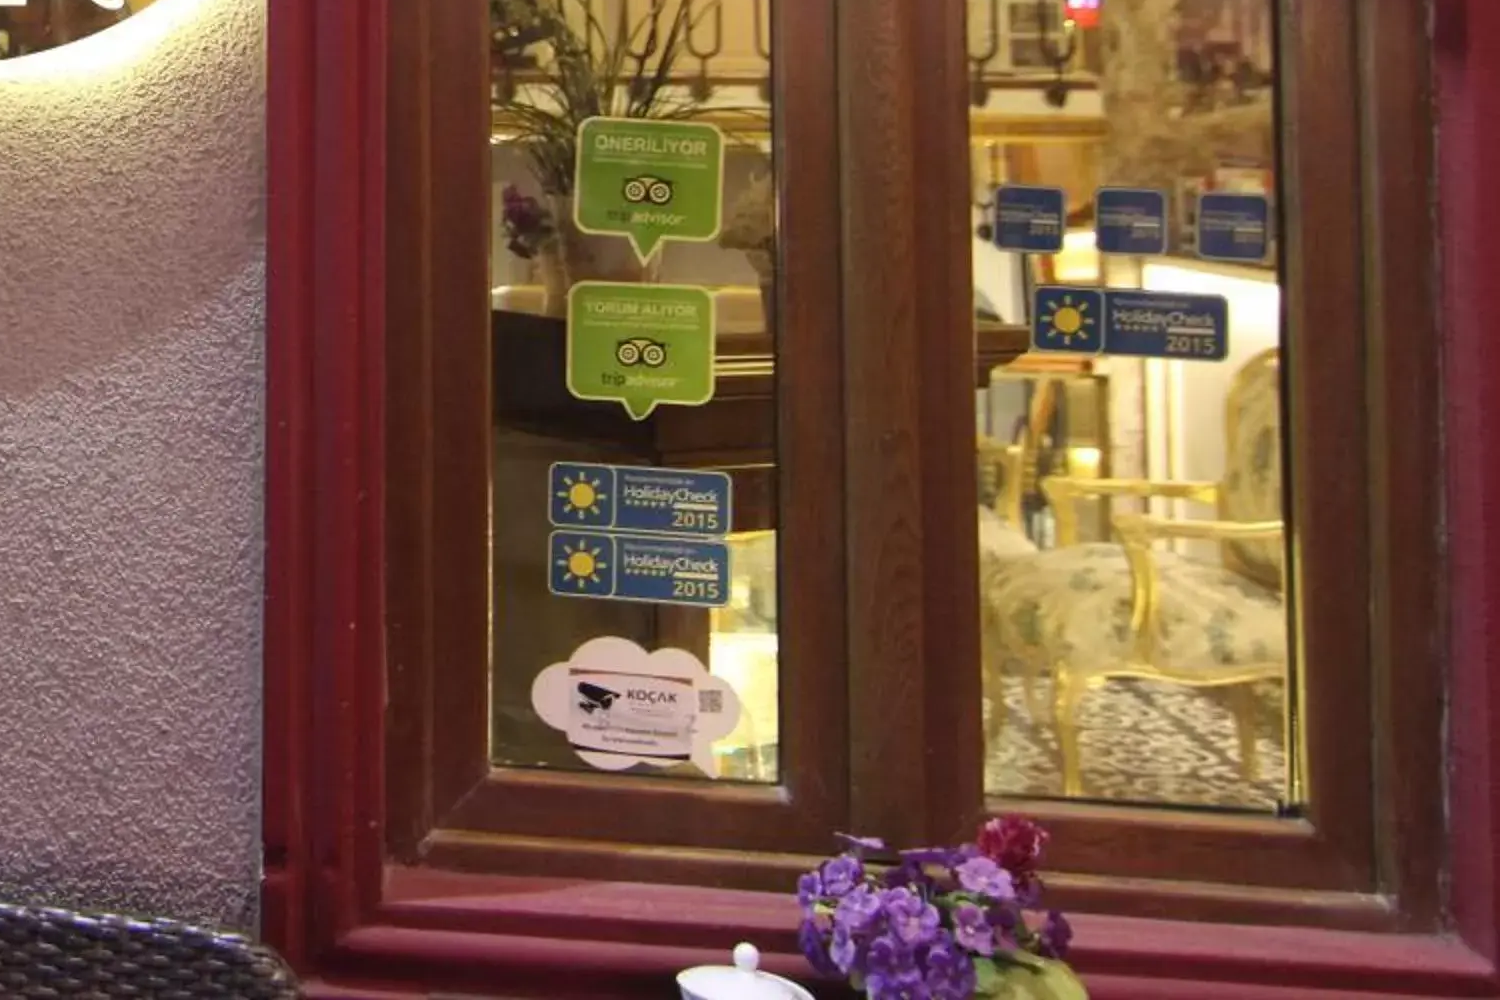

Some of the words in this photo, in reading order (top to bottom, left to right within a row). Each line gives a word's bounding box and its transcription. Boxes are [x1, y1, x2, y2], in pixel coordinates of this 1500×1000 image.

[1165, 336, 1216, 354] 2015
[623, 484, 718, 505] HolidayCheck
[672, 511, 719, 529] 2015
[623, 552, 719, 575] HolidayCheck
[672, 580, 720, 599] 2015
[626, 688, 678, 705] KOÇAK
